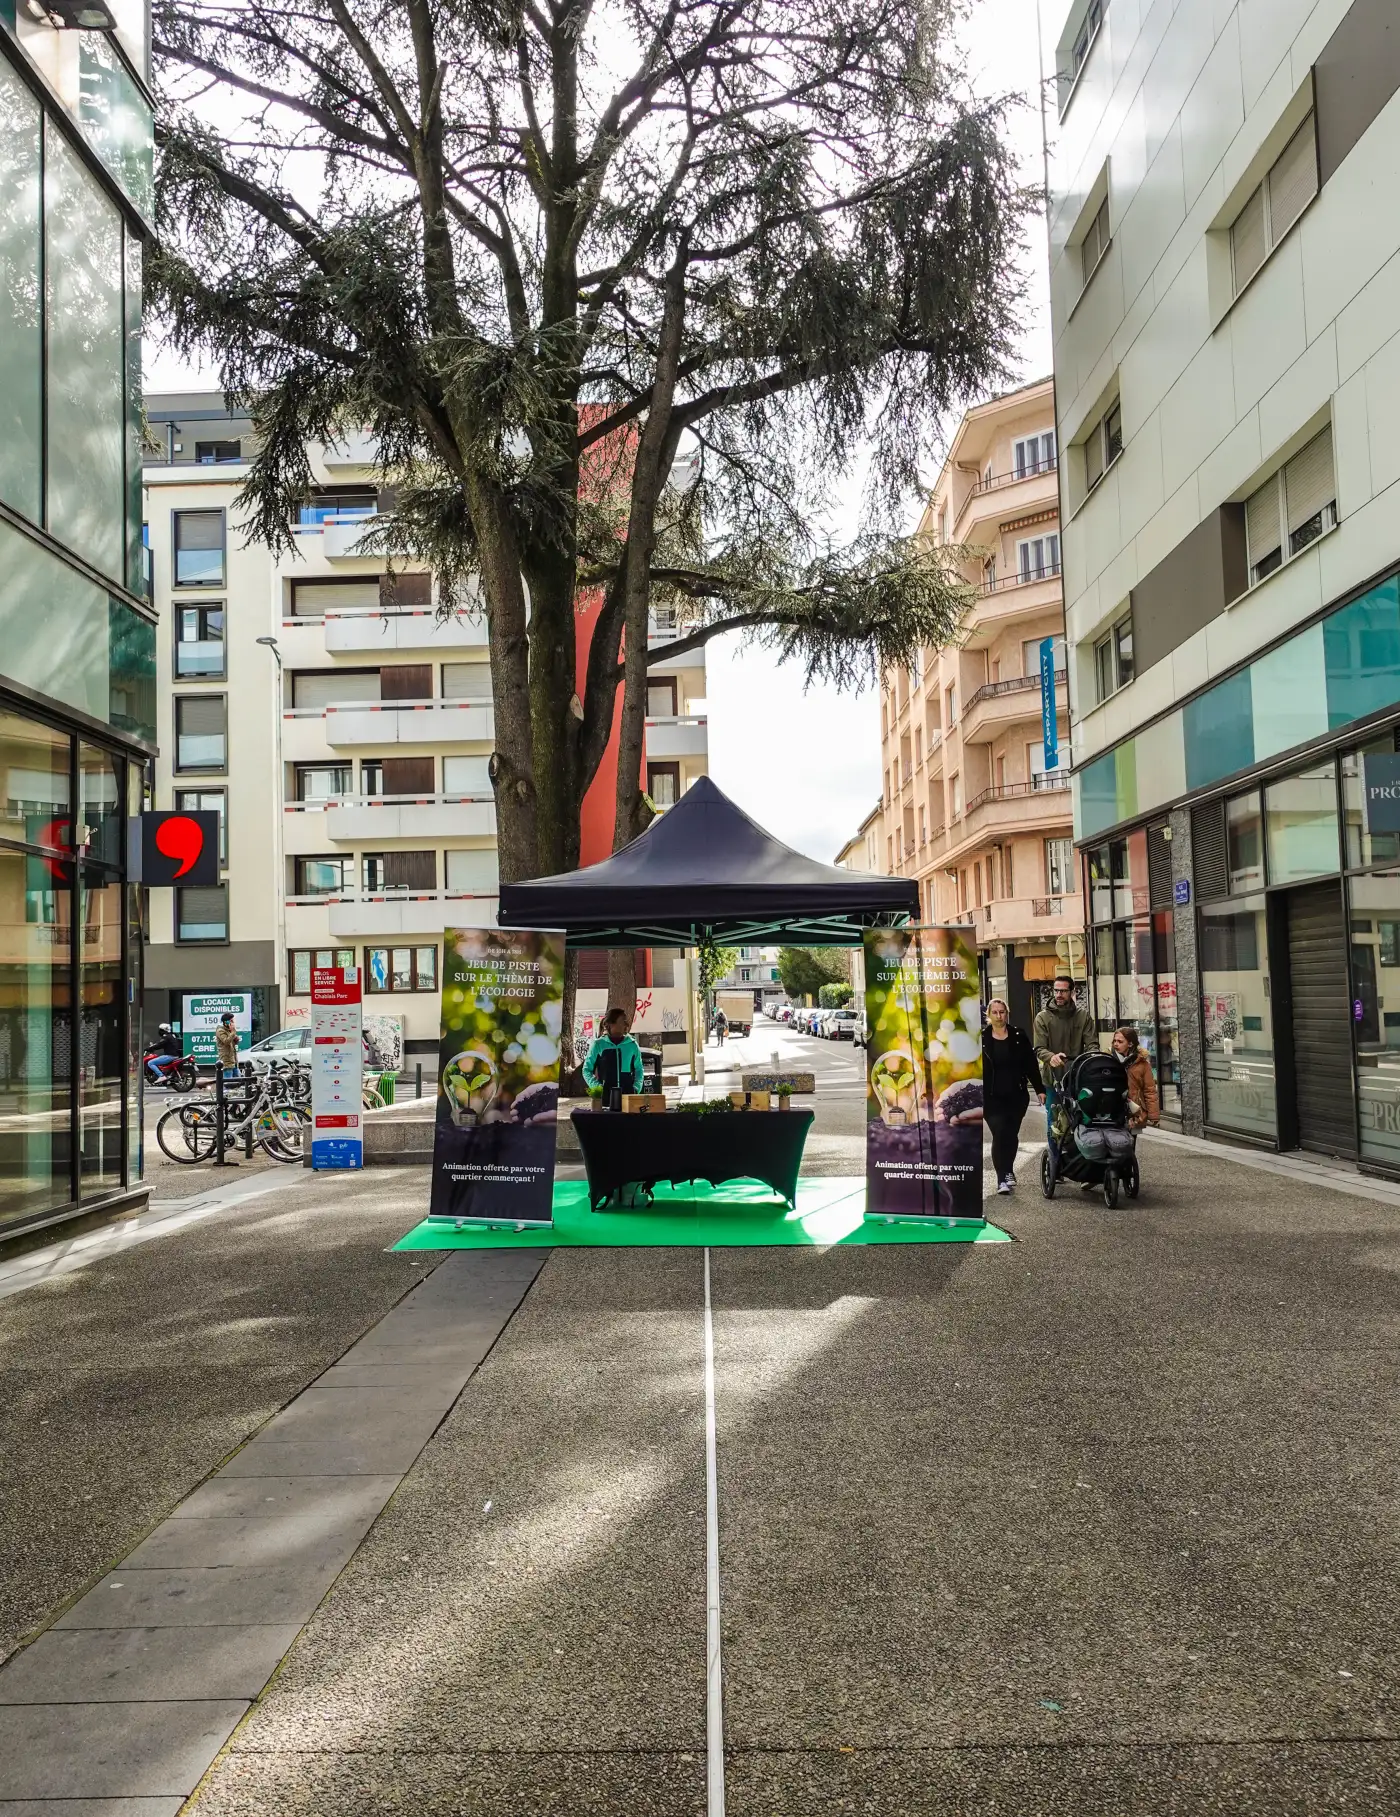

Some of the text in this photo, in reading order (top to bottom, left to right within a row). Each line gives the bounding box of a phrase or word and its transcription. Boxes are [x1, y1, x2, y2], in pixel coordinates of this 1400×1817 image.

[1043, 655, 1052, 746] APPART'CITY
[467, 960, 539, 971] JEU DE PISTE
[884, 957, 957, 968] JEU DE PISTE
[454, 972, 552, 985] SUR LE THÈME DE
[876, 969, 966, 981] SUR LE THÈME DE
[471, 984, 535, 997] L'ÉCOLOGIE
[202, 998, 231, 1006] LOCAUX
[194, 1005, 240, 1013] DISPONIBLES
[442, 1162, 481, 1170] Animation
[482, 1163, 509, 1171] offerte
[875, 1160, 913, 1169] Animation
[914, 1162, 937, 1170] offerte
[939, 1164, 952, 1172] par
[451, 1172, 482, 1181] quartier
[483, 1175, 531, 1183] commerçant
[883, 1171, 914, 1180] quartier
[915, 1173, 961, 1182] commerçant
